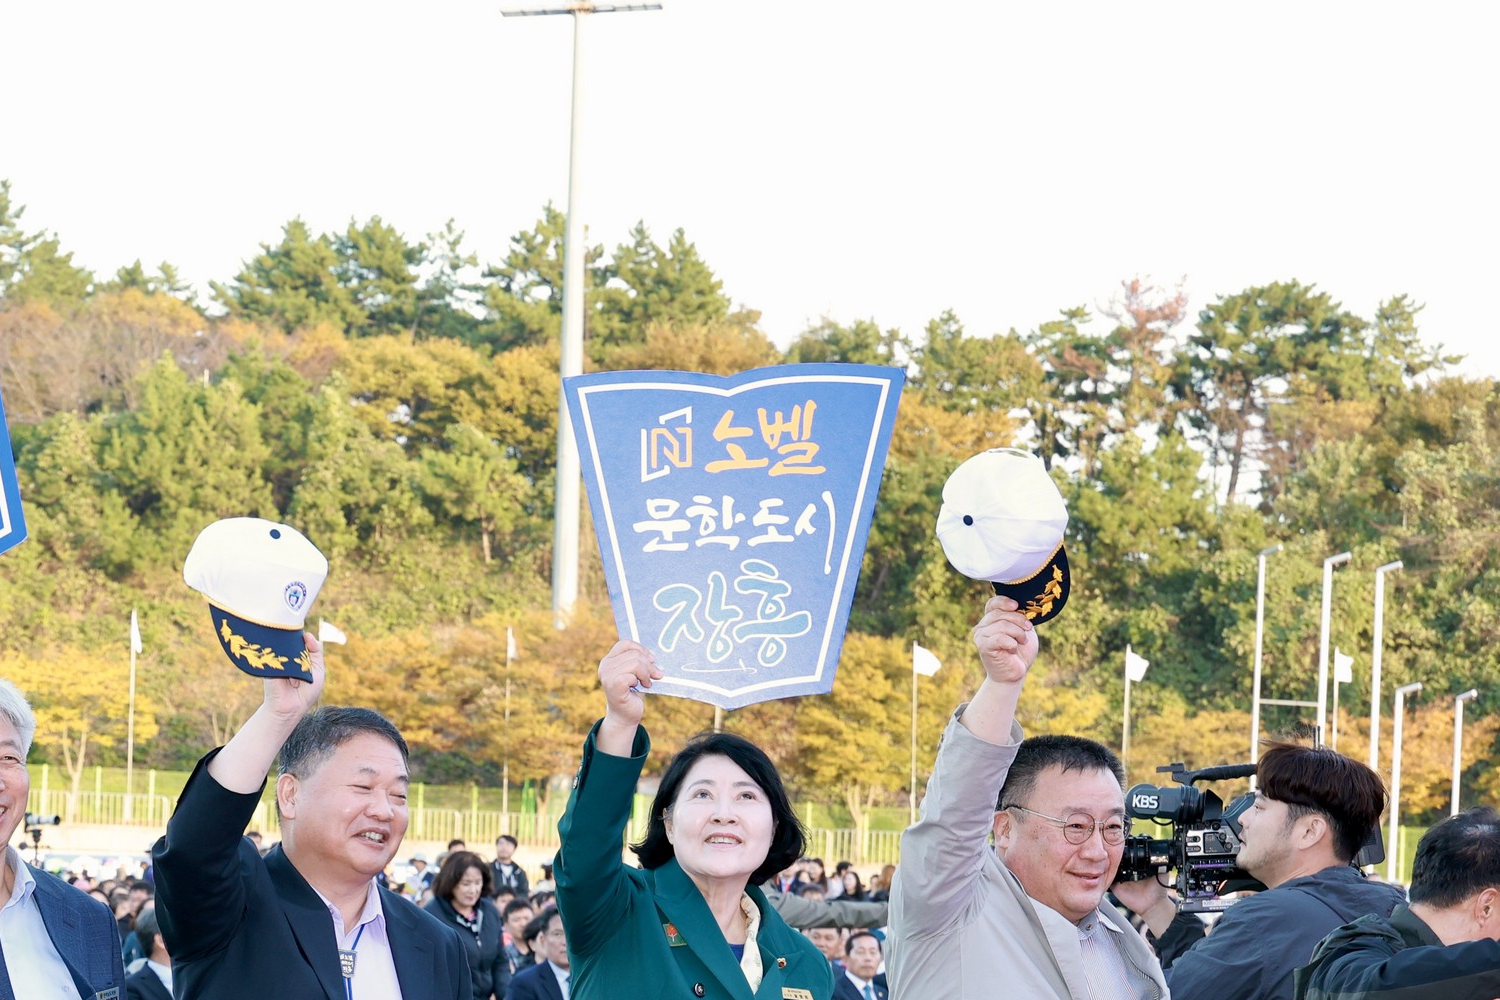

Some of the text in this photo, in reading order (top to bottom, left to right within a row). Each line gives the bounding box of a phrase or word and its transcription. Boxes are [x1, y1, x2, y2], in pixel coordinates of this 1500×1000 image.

[704, 399, 827, 477] 노벨
[632, 490, 837, 575] 문학도시
[652, 558, 813, 668] 장흥
[1132, 794, 1158, 809] KBS
